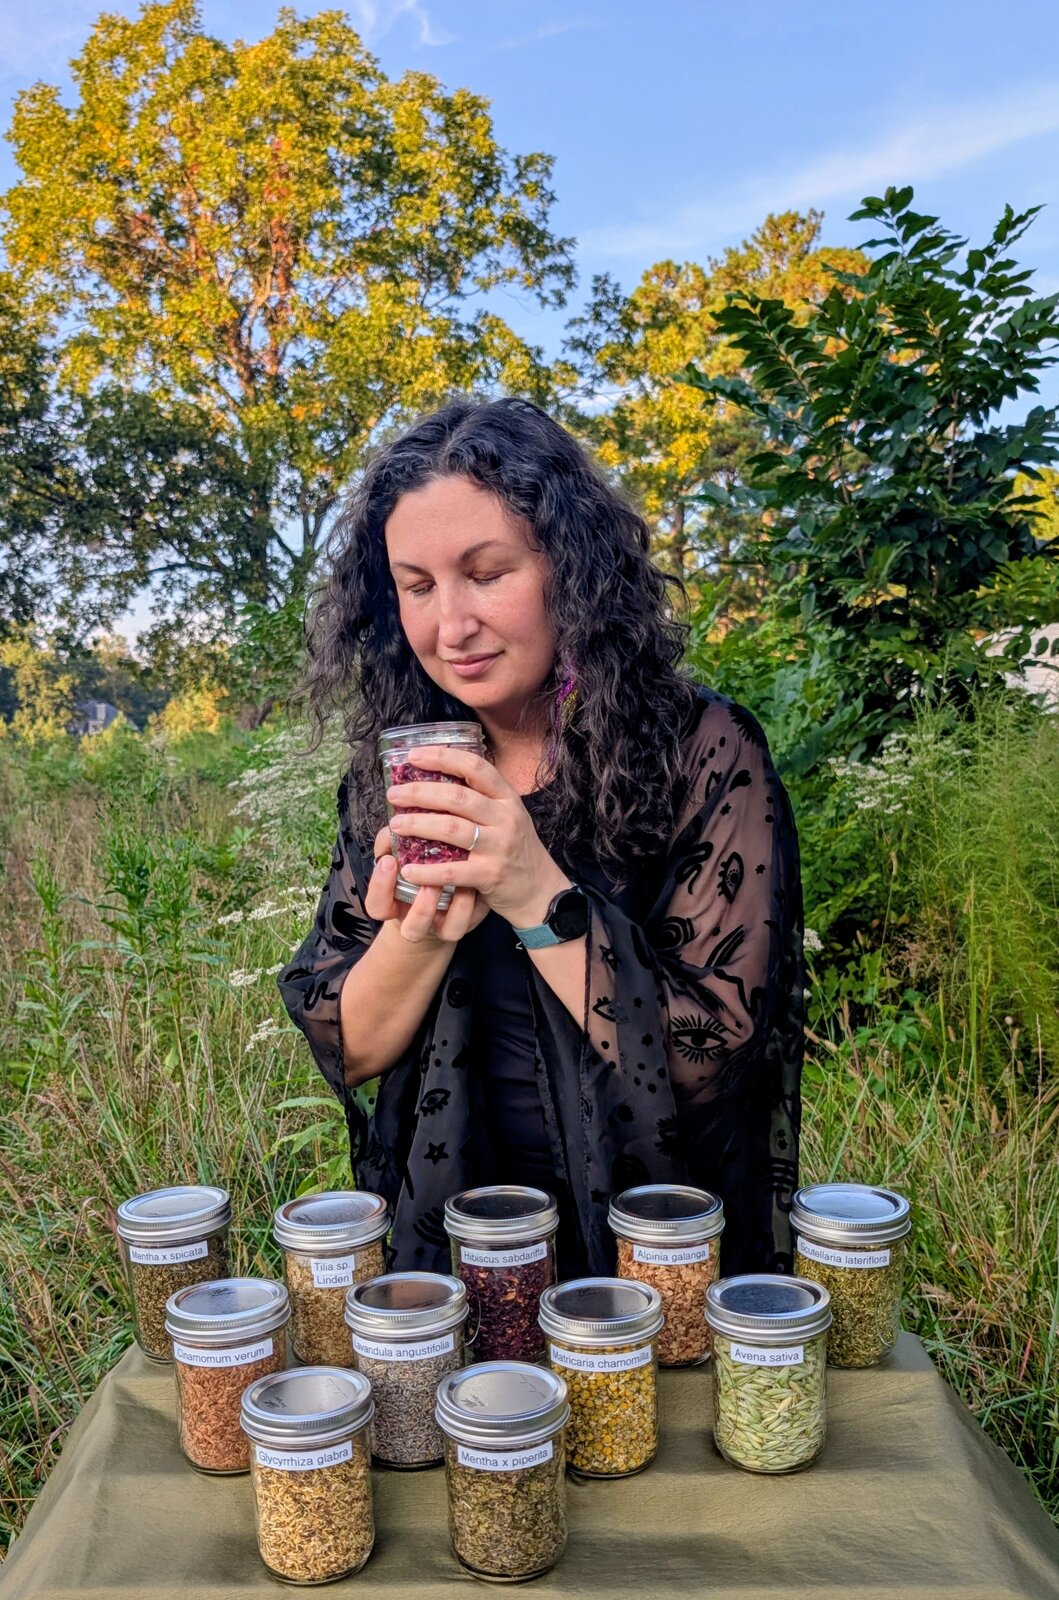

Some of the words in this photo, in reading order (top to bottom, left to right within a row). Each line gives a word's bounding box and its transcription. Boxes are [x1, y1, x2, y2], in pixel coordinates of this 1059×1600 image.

[132, 1250, 160, 1261] Mentha
[170, 1247, 203, 1260] spicata
[464, 1252, 500, 1264] Hibiscus
[638, 1250, 668, 1262] Alpinia
[672, 1250, 706, 1262] galanga
[800, 1242, 842, 1263] Scutellaria
[845, 1256, 888, 1264] lateriflora
[314, 1262, 334, 1272] Tilia
[336, 1262, 350, 1270] sp.
[316, 1275, 349, 1285] Linden
[234, 1348, 264, 1360] verum
[396, 1340, 450, 1358] angustifolia
[735, 1348, 766, 1362] Avena
[770, 1352, 799, 1362] sativa
[552, 1349, 594, 1368] Matricaria
[598, 1352, 649, 1368] chamomilla
[259, 1451, 313, 1466] Glycyrrhiza
[317, 1448, 348, 1465] glabra
[462, 1451, 498, 1466] Mentha
[502, 1459, 509, 1467] x
[512, 1449, 548, 1466] piperita
